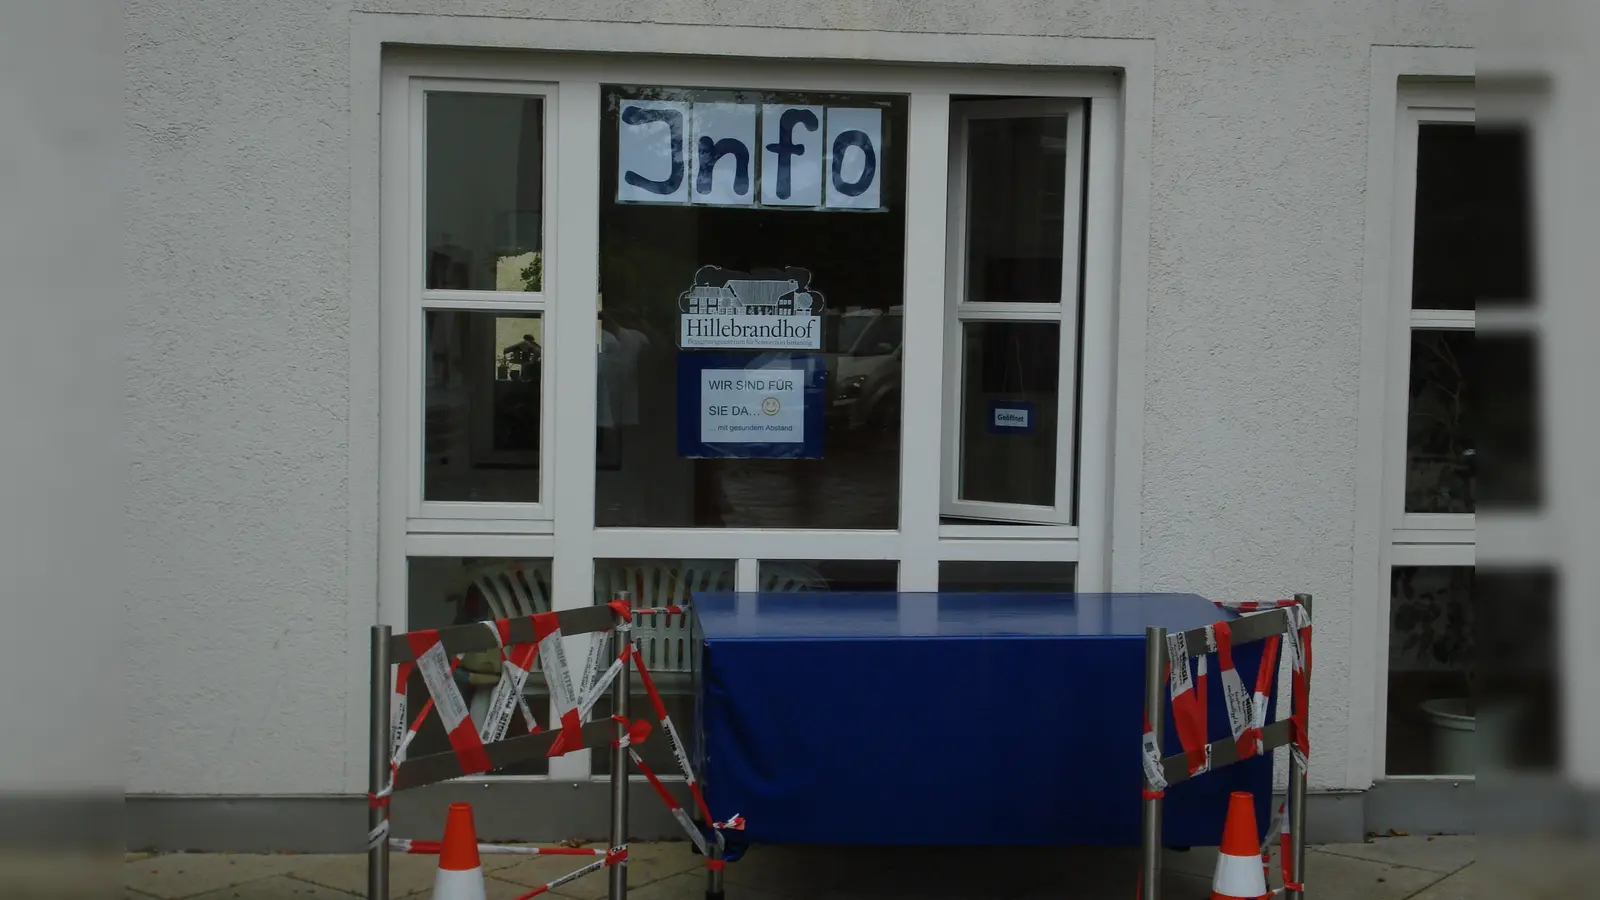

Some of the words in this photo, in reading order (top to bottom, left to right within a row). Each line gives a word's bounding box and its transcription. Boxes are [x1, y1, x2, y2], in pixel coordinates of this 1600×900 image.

[686, 318, 816, 338] Hillebrandhof
[708, 380, 732, 390] WIR
[736, 380, 765, 391] SIND
[768, 379, 794, 391] FÜR
[708, 405, 729, 416] SIE
[998, 413, 1024, 423] Geöffnet
[717, 424, 729, 432] mit
[729, 425, 765, 433] gesundem
[765, 424, 793, 432] Abstand
